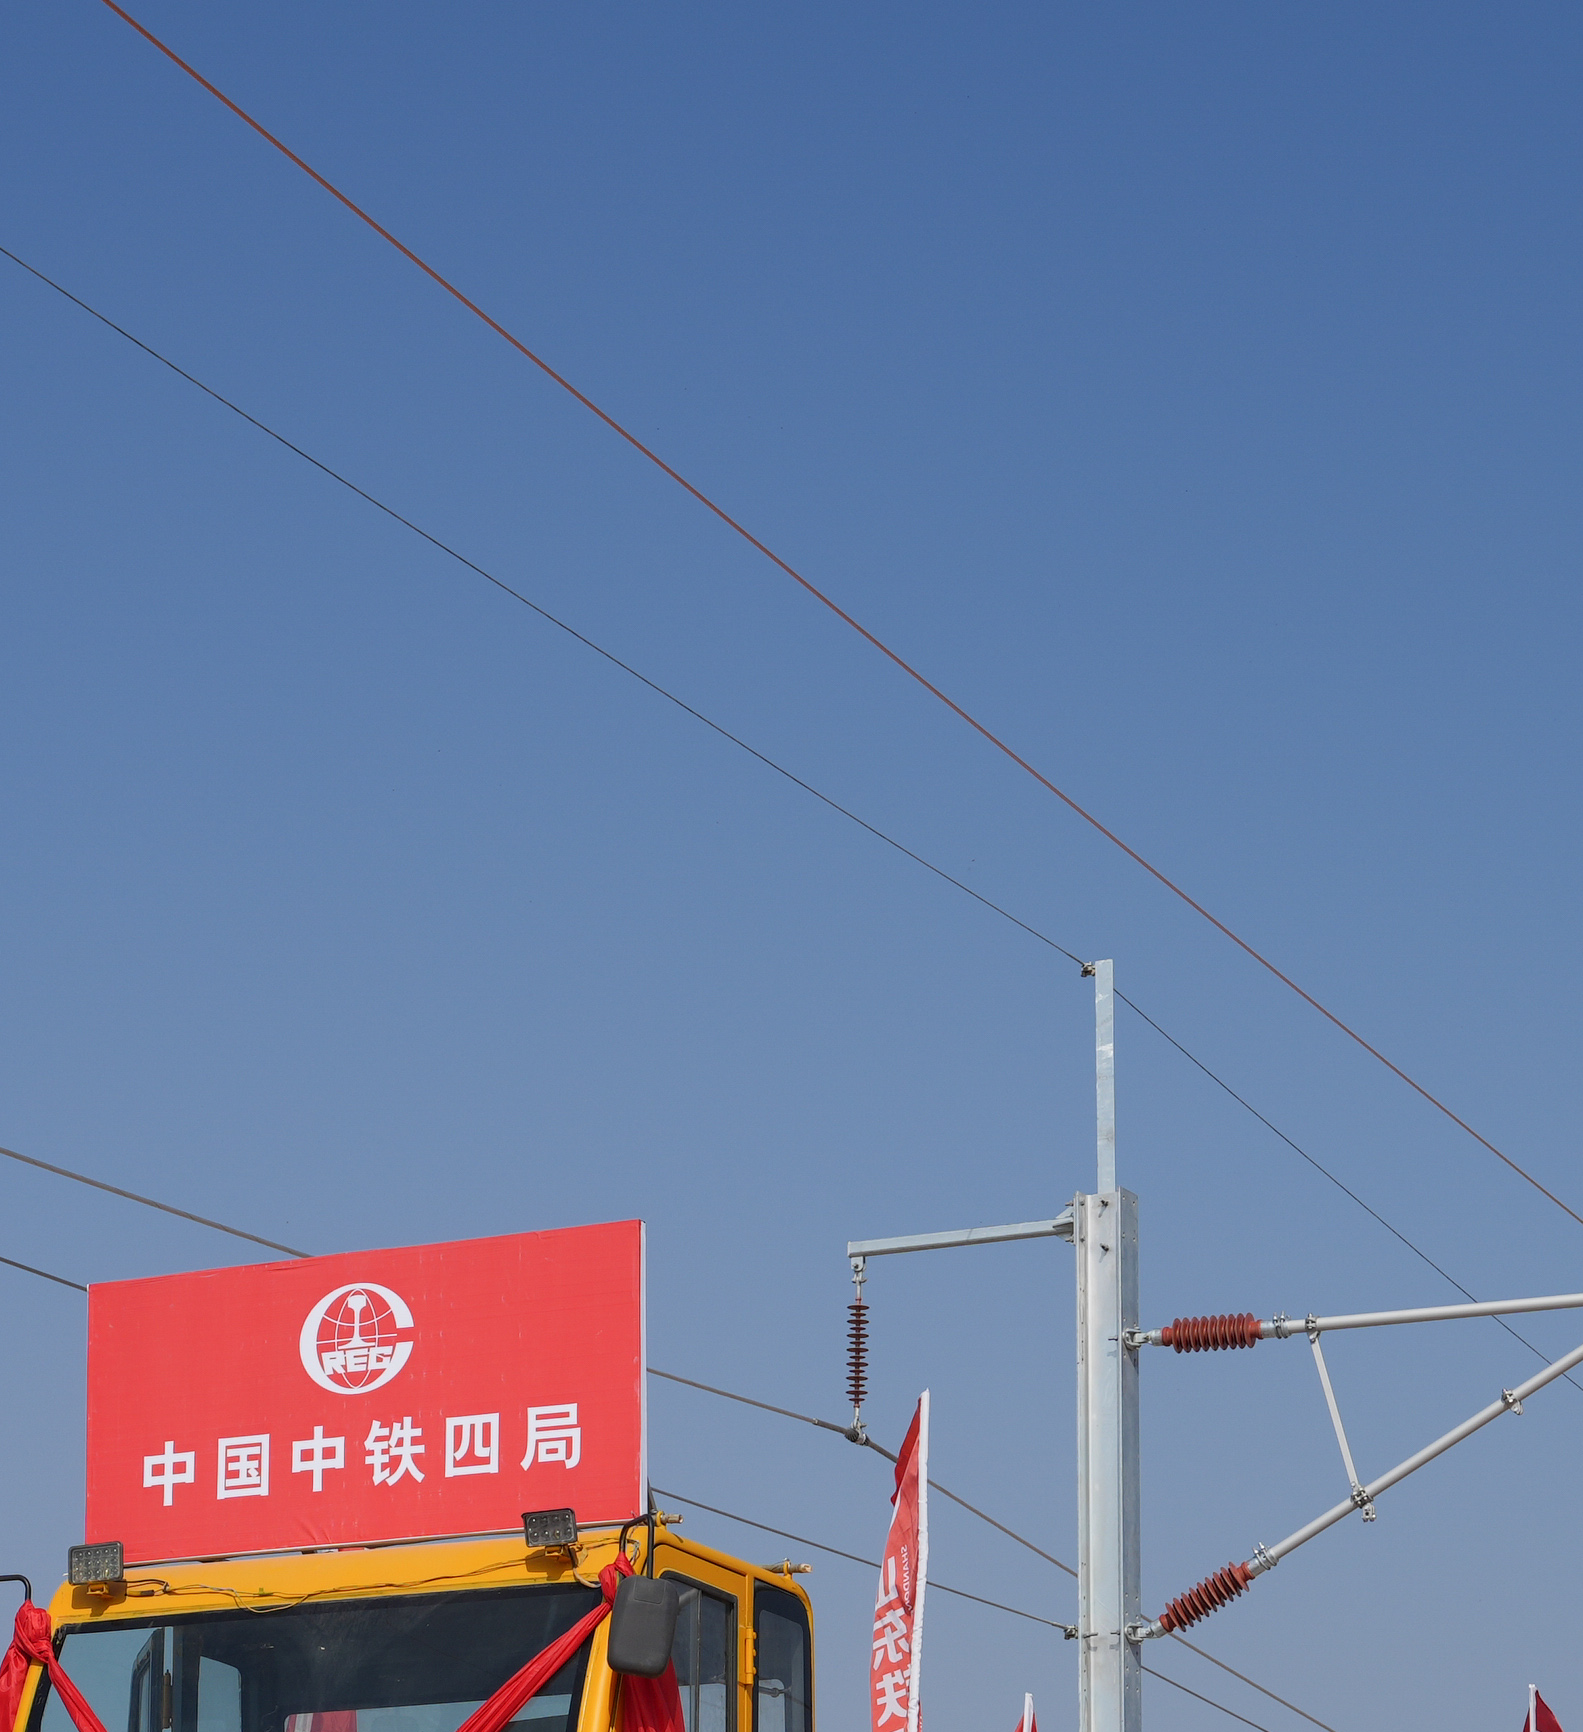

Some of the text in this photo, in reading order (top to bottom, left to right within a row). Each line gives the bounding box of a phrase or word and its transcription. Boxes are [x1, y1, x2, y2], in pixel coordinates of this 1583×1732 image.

[143, 1403, 582, 1506] 中国中铁四局
